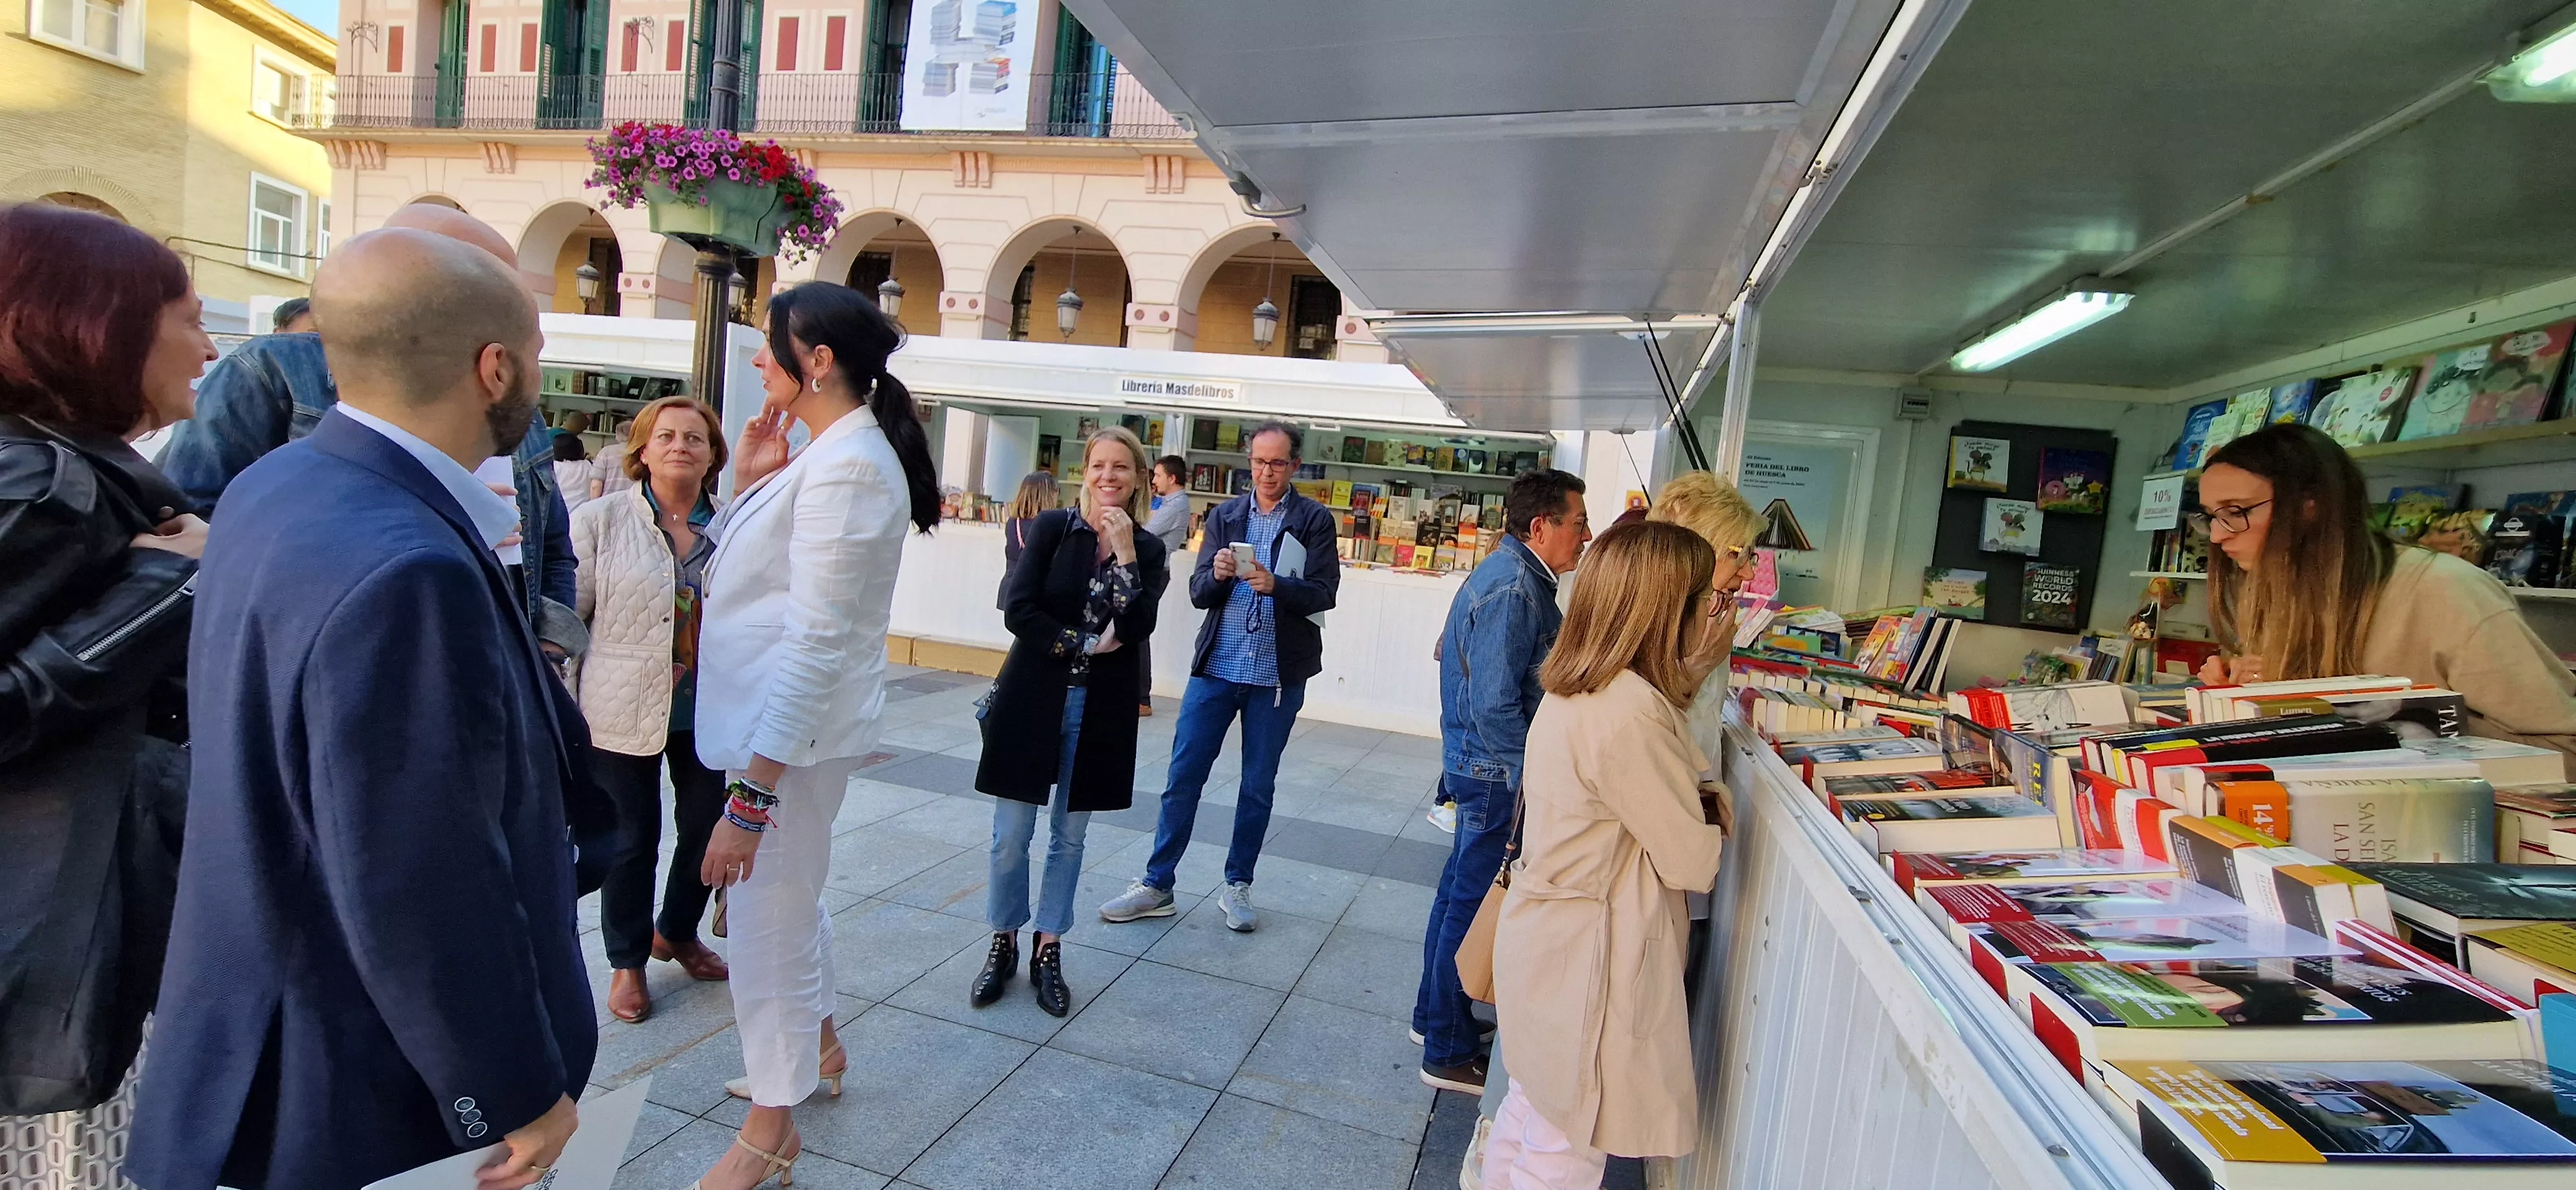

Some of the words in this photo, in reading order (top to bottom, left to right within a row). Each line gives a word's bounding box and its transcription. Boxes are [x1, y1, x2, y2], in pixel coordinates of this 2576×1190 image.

[1122, 379, 1162, 394] Librería
[1166, 382, 1235, 399] Masdelibros
[2153, 489, 2172, 502] 10%
[2034, 574, 2074, 585] WORLD
[2035, 568, 2075, 578] GUINNESS
[2032, 583, 2073, 592] RECORDS
[2031, 589, 2073, 605] 2024
[2279, 706, 2313, 716] Lumen
[2358, 802, 2376, 834] SAN
[2333, 823, 2350, 843] LA
